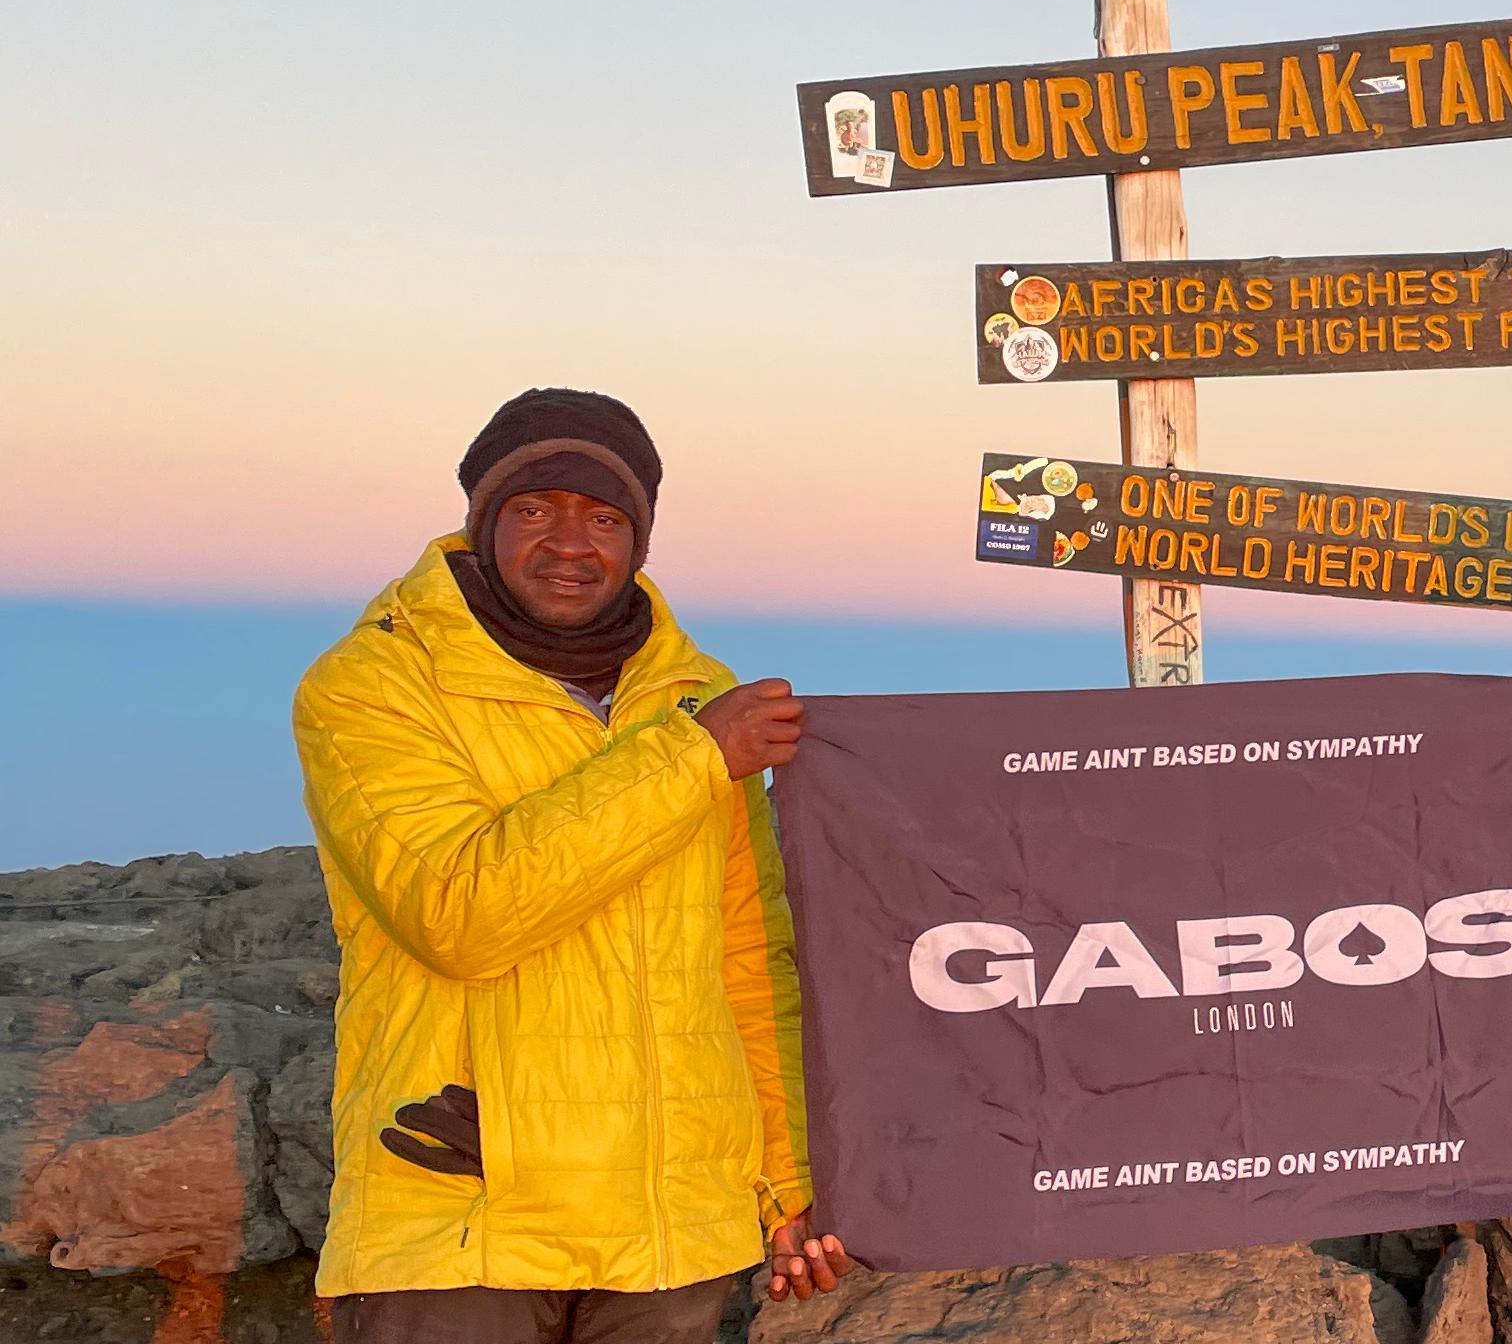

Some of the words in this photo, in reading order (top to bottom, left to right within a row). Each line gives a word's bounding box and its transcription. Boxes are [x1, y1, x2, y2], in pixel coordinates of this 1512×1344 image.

[892, 70, 1149, 170] UHURU
[1167, 49, 1385, 150] PEAK,
[1059, 276, 1274, 318] AFRICAS
[1289, 268, 1488, 310] HIGHEST
[1058, 319, 1260, 363] WORLD'S
[1275, 311, 1485, 356] HIGHEST
[1120, 474, 1215, 524] ONE
[1227, 484, 1283, 529] OF
[1296, 491, 1490, 548] WORLD'S
[1113, 524, 1273, 579] WORLD
[1003, 750, 1079, 774] GAME
[1083, 747, 1147, 771] AINT
[1152, 743, 1237, 767] BASED
[1243, 741, 1280, 762] ON
[1286, 733, 1424, 761] SYMPATHY
[1192, 1000, 1296, 1035] LONDON
[1033, 1166, 1110, 1192] GAME
[1114, 1162, 1180, 1188] AINT
[1185, 1156, 1271, 1183] BASED
[1277, 1152, 1317, 1176] ON
[1322, 1139, 1466, 1173] SYMPATHY
